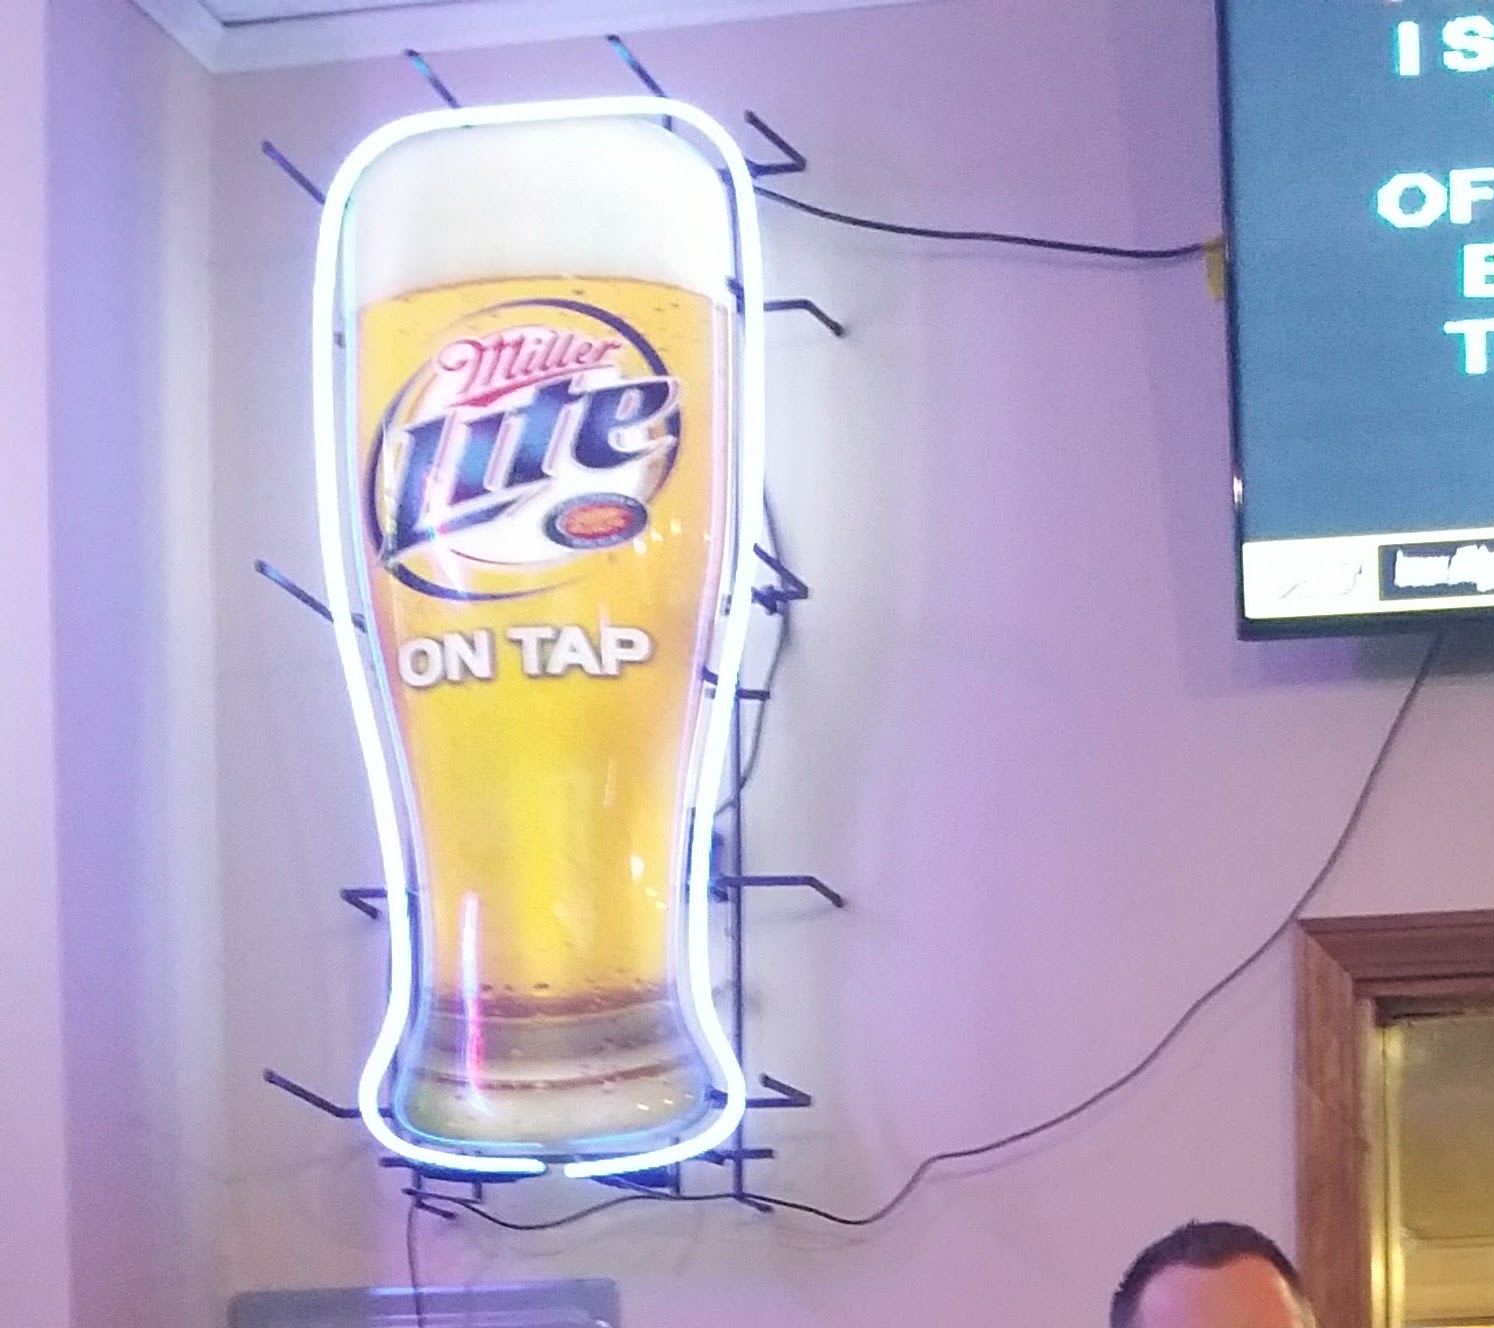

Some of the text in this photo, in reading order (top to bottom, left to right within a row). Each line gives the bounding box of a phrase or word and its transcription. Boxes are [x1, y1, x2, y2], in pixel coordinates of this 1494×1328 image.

[1397, 21, 1420, 76] I
[438, 330, 624, 394] Miller
[385, 376, 680, 559] Lite
[397, 624, 653, 688] ON TAP
